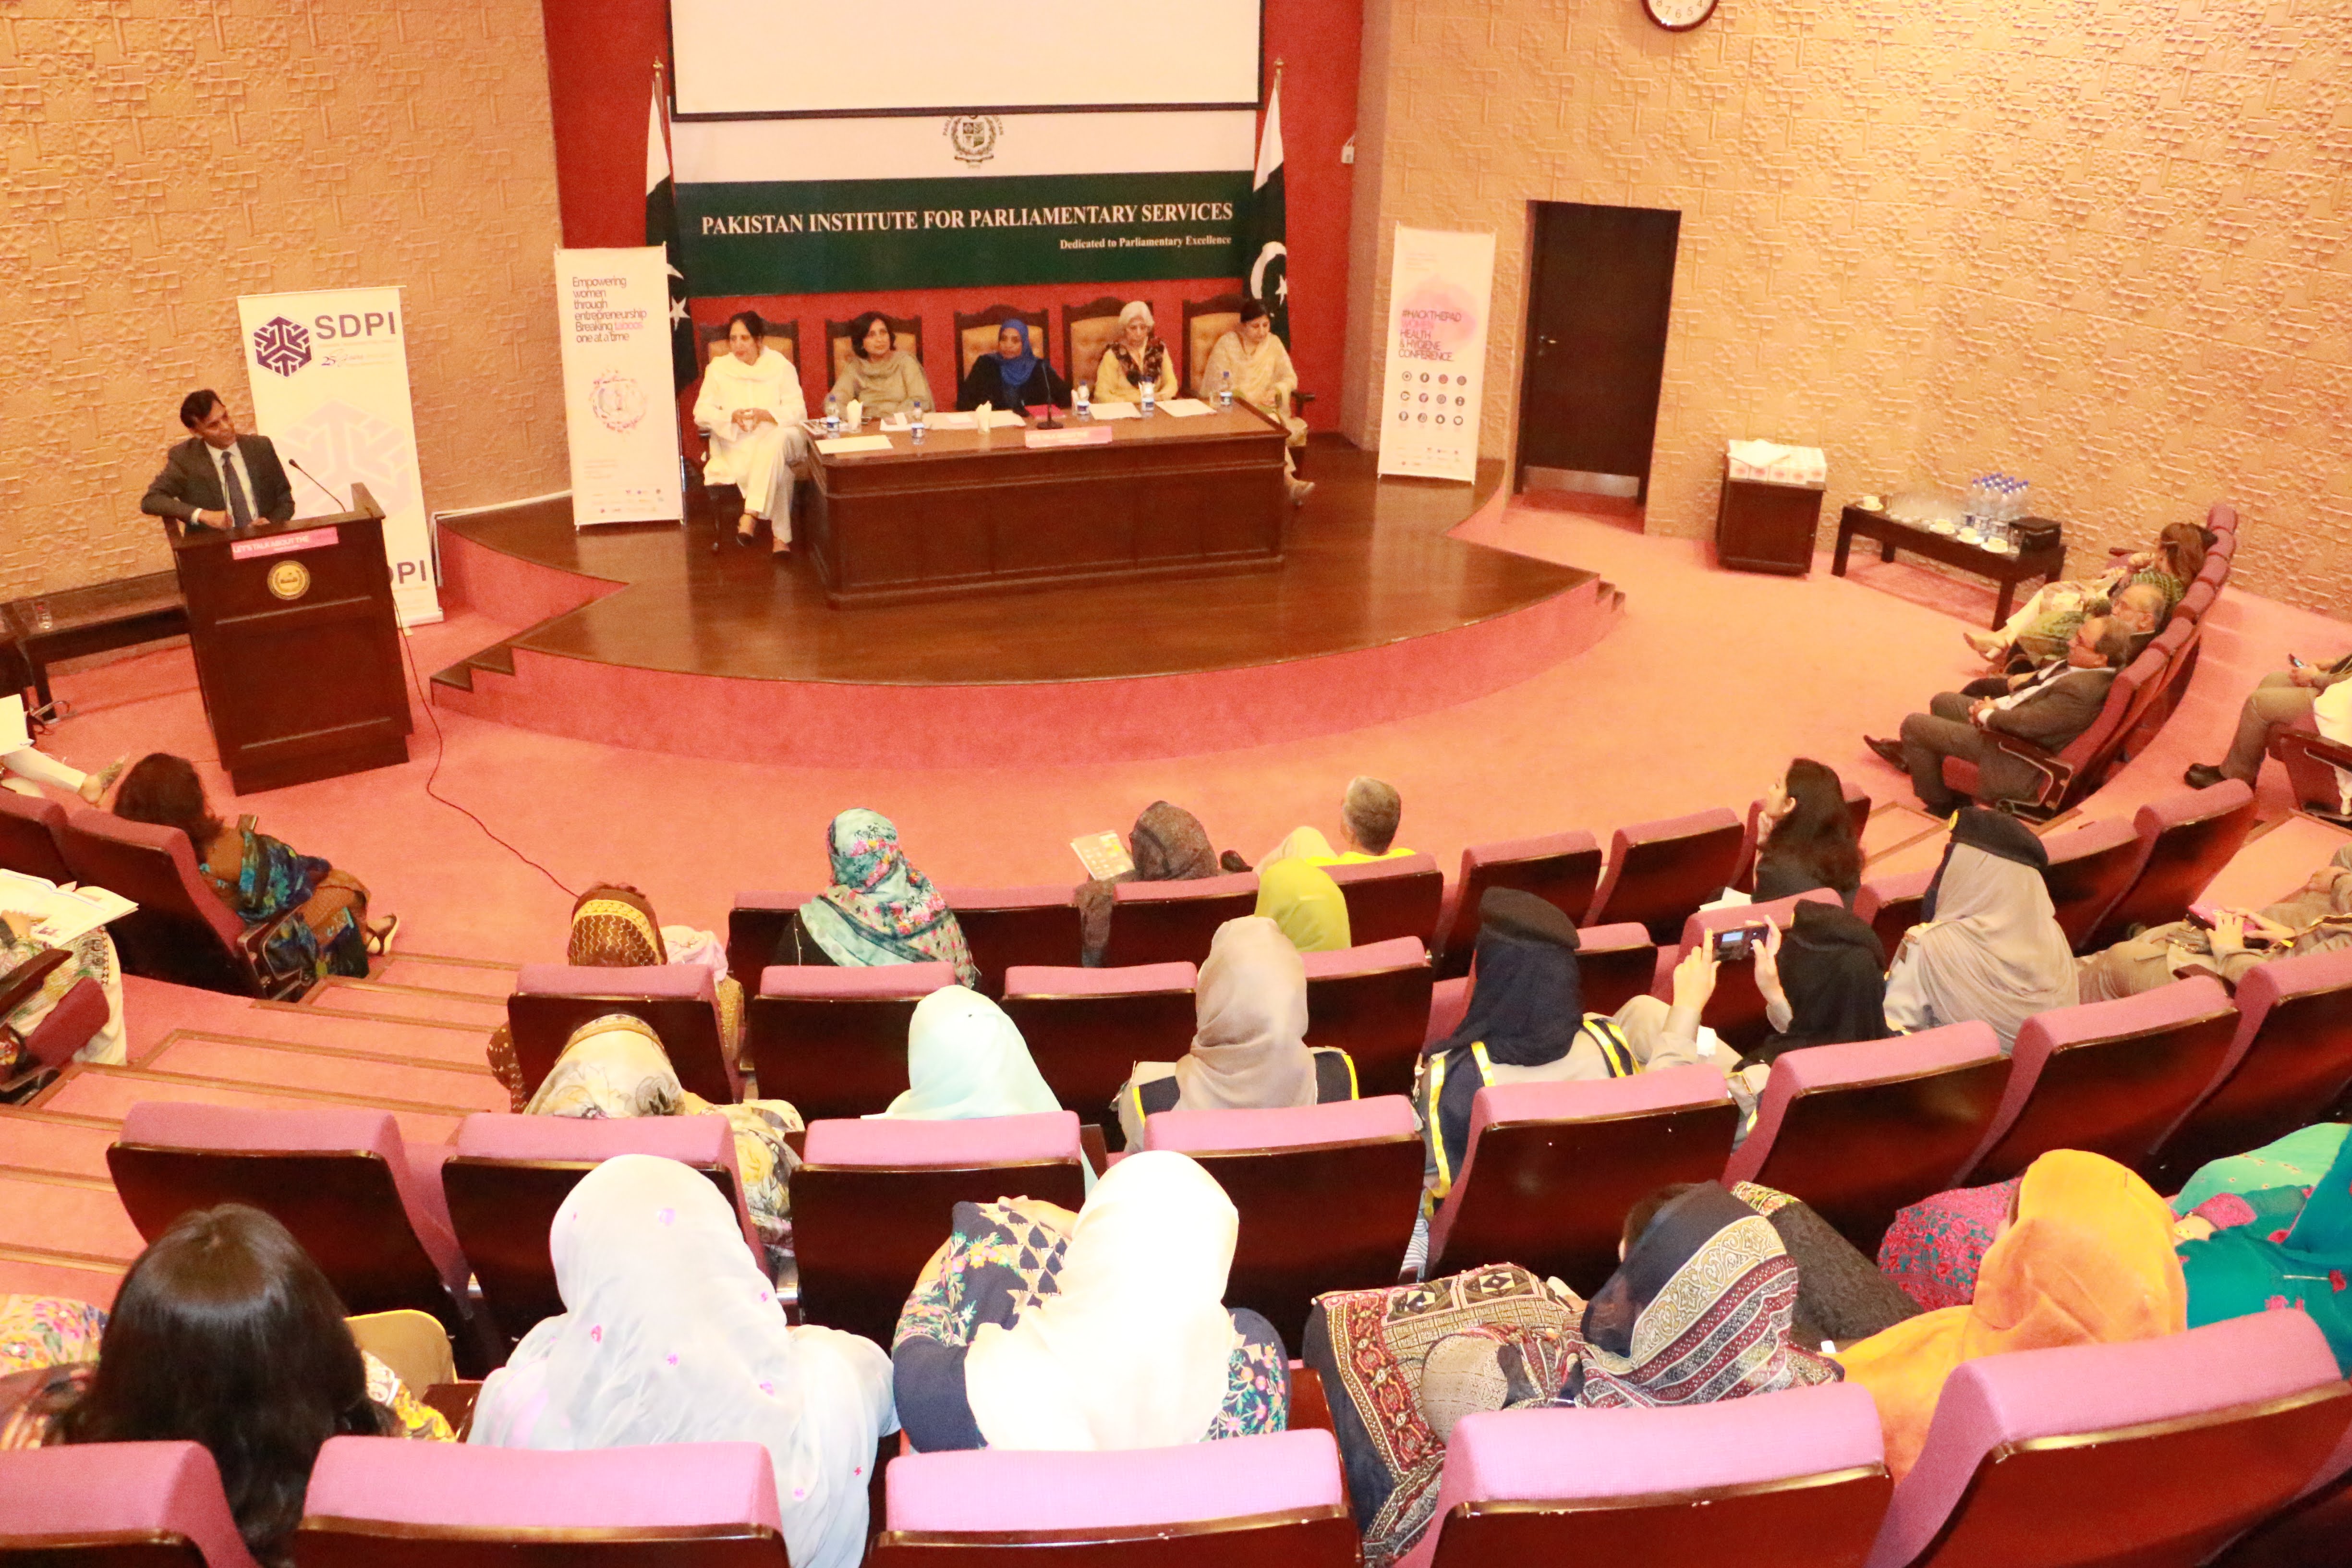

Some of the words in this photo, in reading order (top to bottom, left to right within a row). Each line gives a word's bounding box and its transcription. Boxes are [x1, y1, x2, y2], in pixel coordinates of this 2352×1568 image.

[702, 214, 804, 235] PAKISTAN
[809, 211, 918, 232] INSTITUTE
[923, 209, 965, 229] FOR
[970, 204, 1139, 228] PARLIAMENTARY
[1141, 202, 1233, 222] SERVICES
[1060, 238, 1105, 249] Dedicated
[1107, 238, 1116, 247] to
[1119, 236, 1183, 248] Parliamentary
[1186, 235, 1232, 245] Excellence
[572, 275, 627, 289] Empowering
[573, 289, 606, 298] women
[574, 299, 608, 311] through
[575, 308, 647, 321] entrepreneurship
[315, 311, 396, 340] SDPI
[576, 321, 614, 333] Breaking
[576, 334, 594, 343] one
[594, 333, 603, 342] at
[610, 331, 630, 341] time
[1400, 329, 1431, 340] HEALTH
[1406, 338, 1441, 351] HYGIENE
[253, 542, 270, 550] TALK
[270, 538, 295, 548] ABOUT
